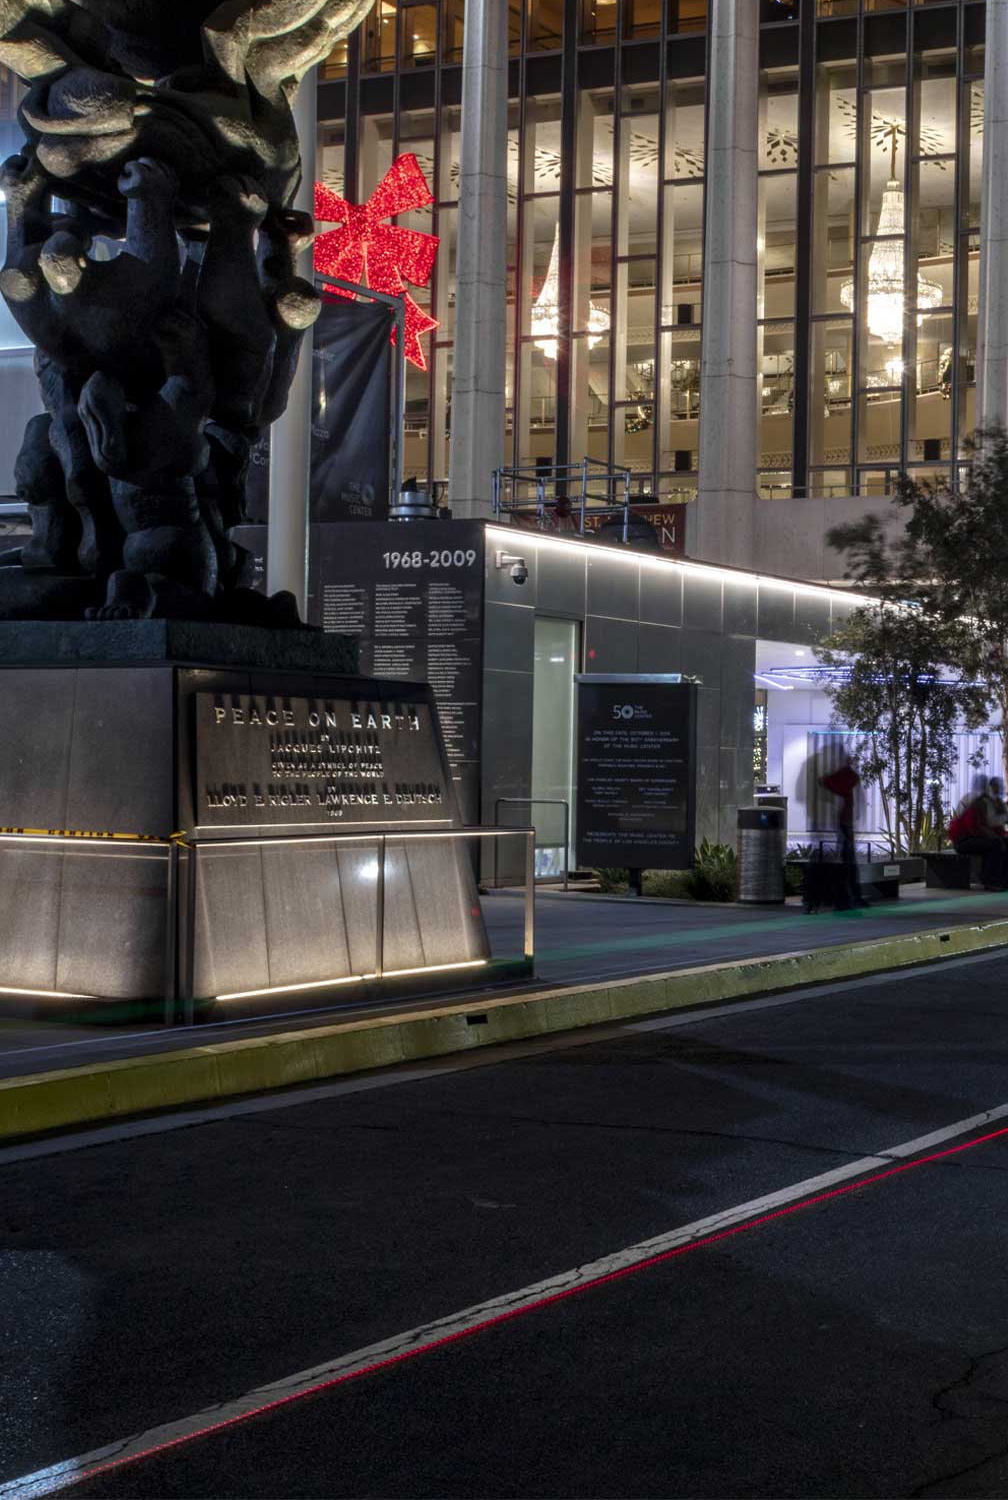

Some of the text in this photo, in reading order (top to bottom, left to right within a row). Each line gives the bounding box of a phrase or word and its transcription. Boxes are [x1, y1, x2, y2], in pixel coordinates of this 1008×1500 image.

[383, 550, 476, 569] 1968-2009
[214, 707, 420, 731] PEACE ON EARTH
[271, 744, 323, 753] JACQUES
[207, 795, 248, 807] LLOYD
[268, 795, 313, 806] RIGLER
[316, 794, 379, 806] LAWRENCE
[395, 794, 442, 805] DEUTSCH
